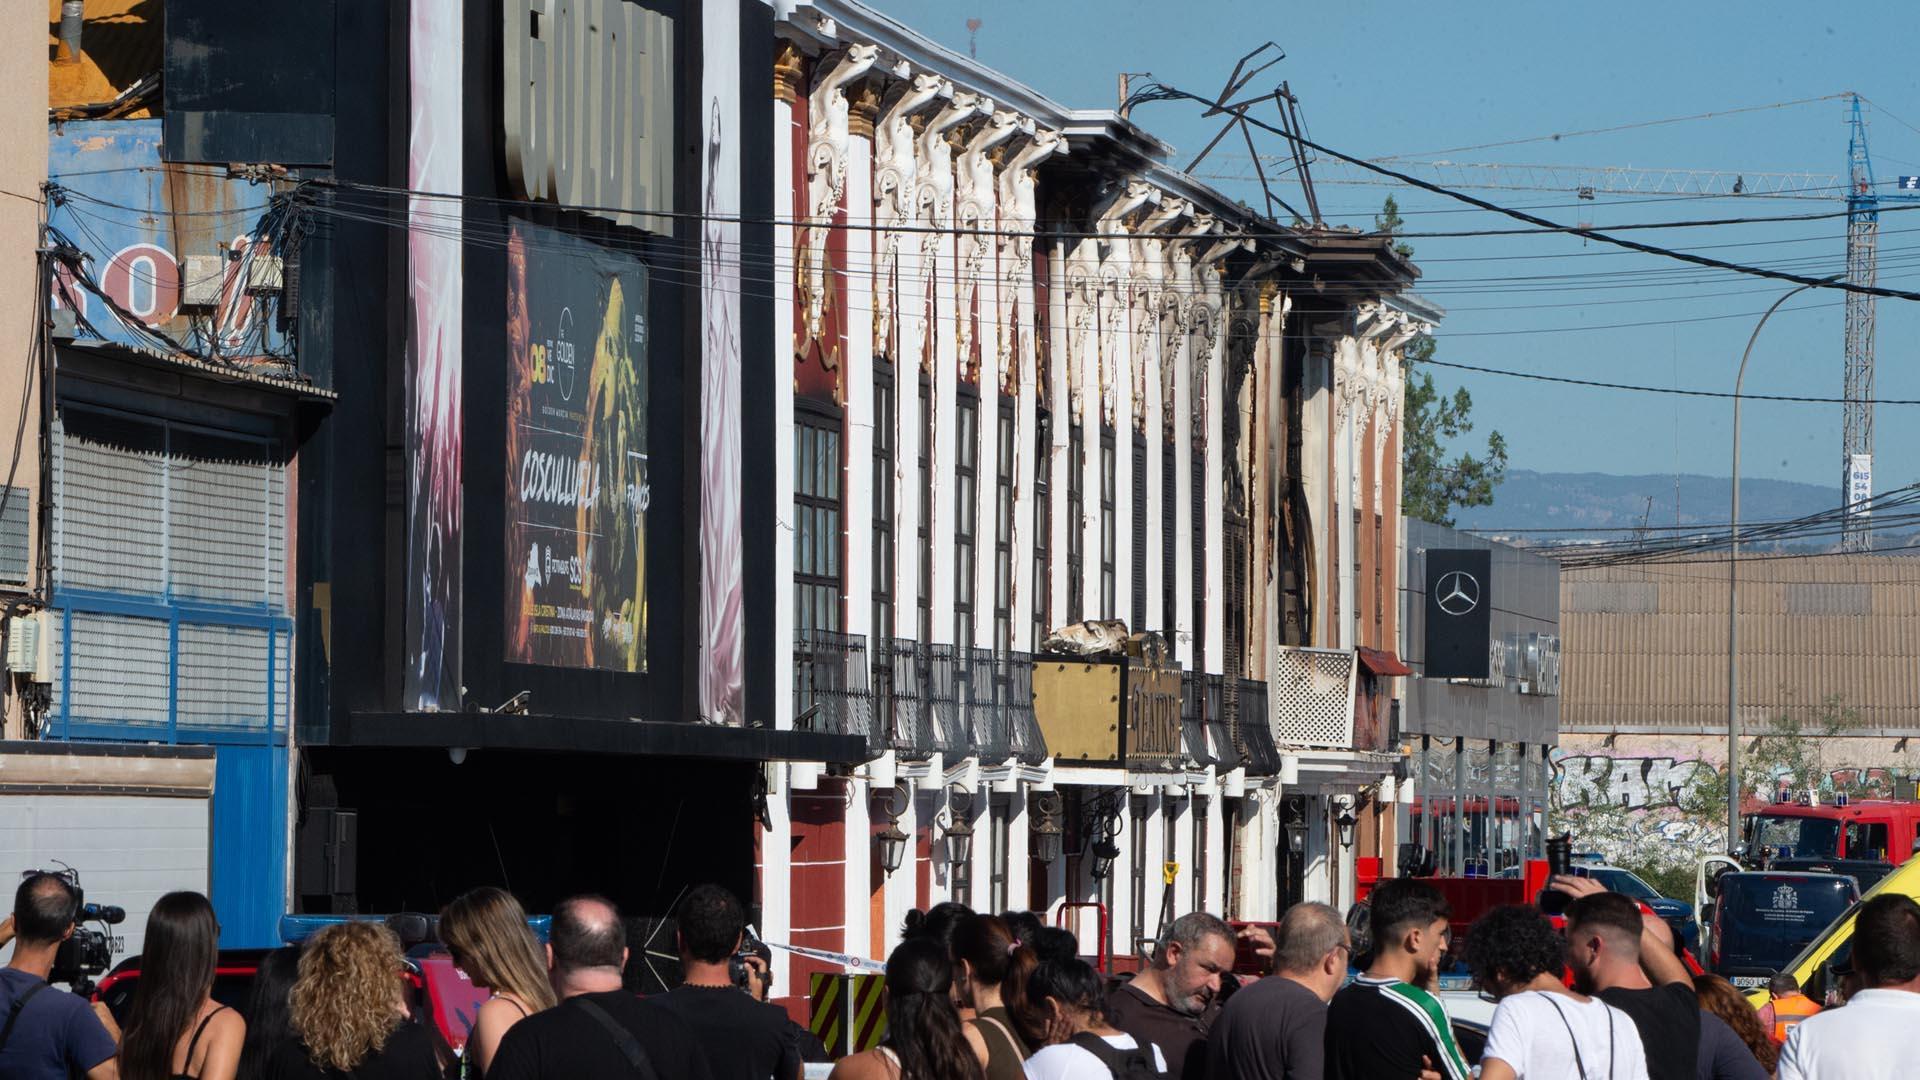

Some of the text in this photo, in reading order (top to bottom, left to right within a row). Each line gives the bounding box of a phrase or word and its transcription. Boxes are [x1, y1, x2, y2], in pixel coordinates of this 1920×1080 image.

[530, 343, 547, 385] 08
[1853, 472, 1869, 480] 615
[1854, 482, 1867, 491] 54
